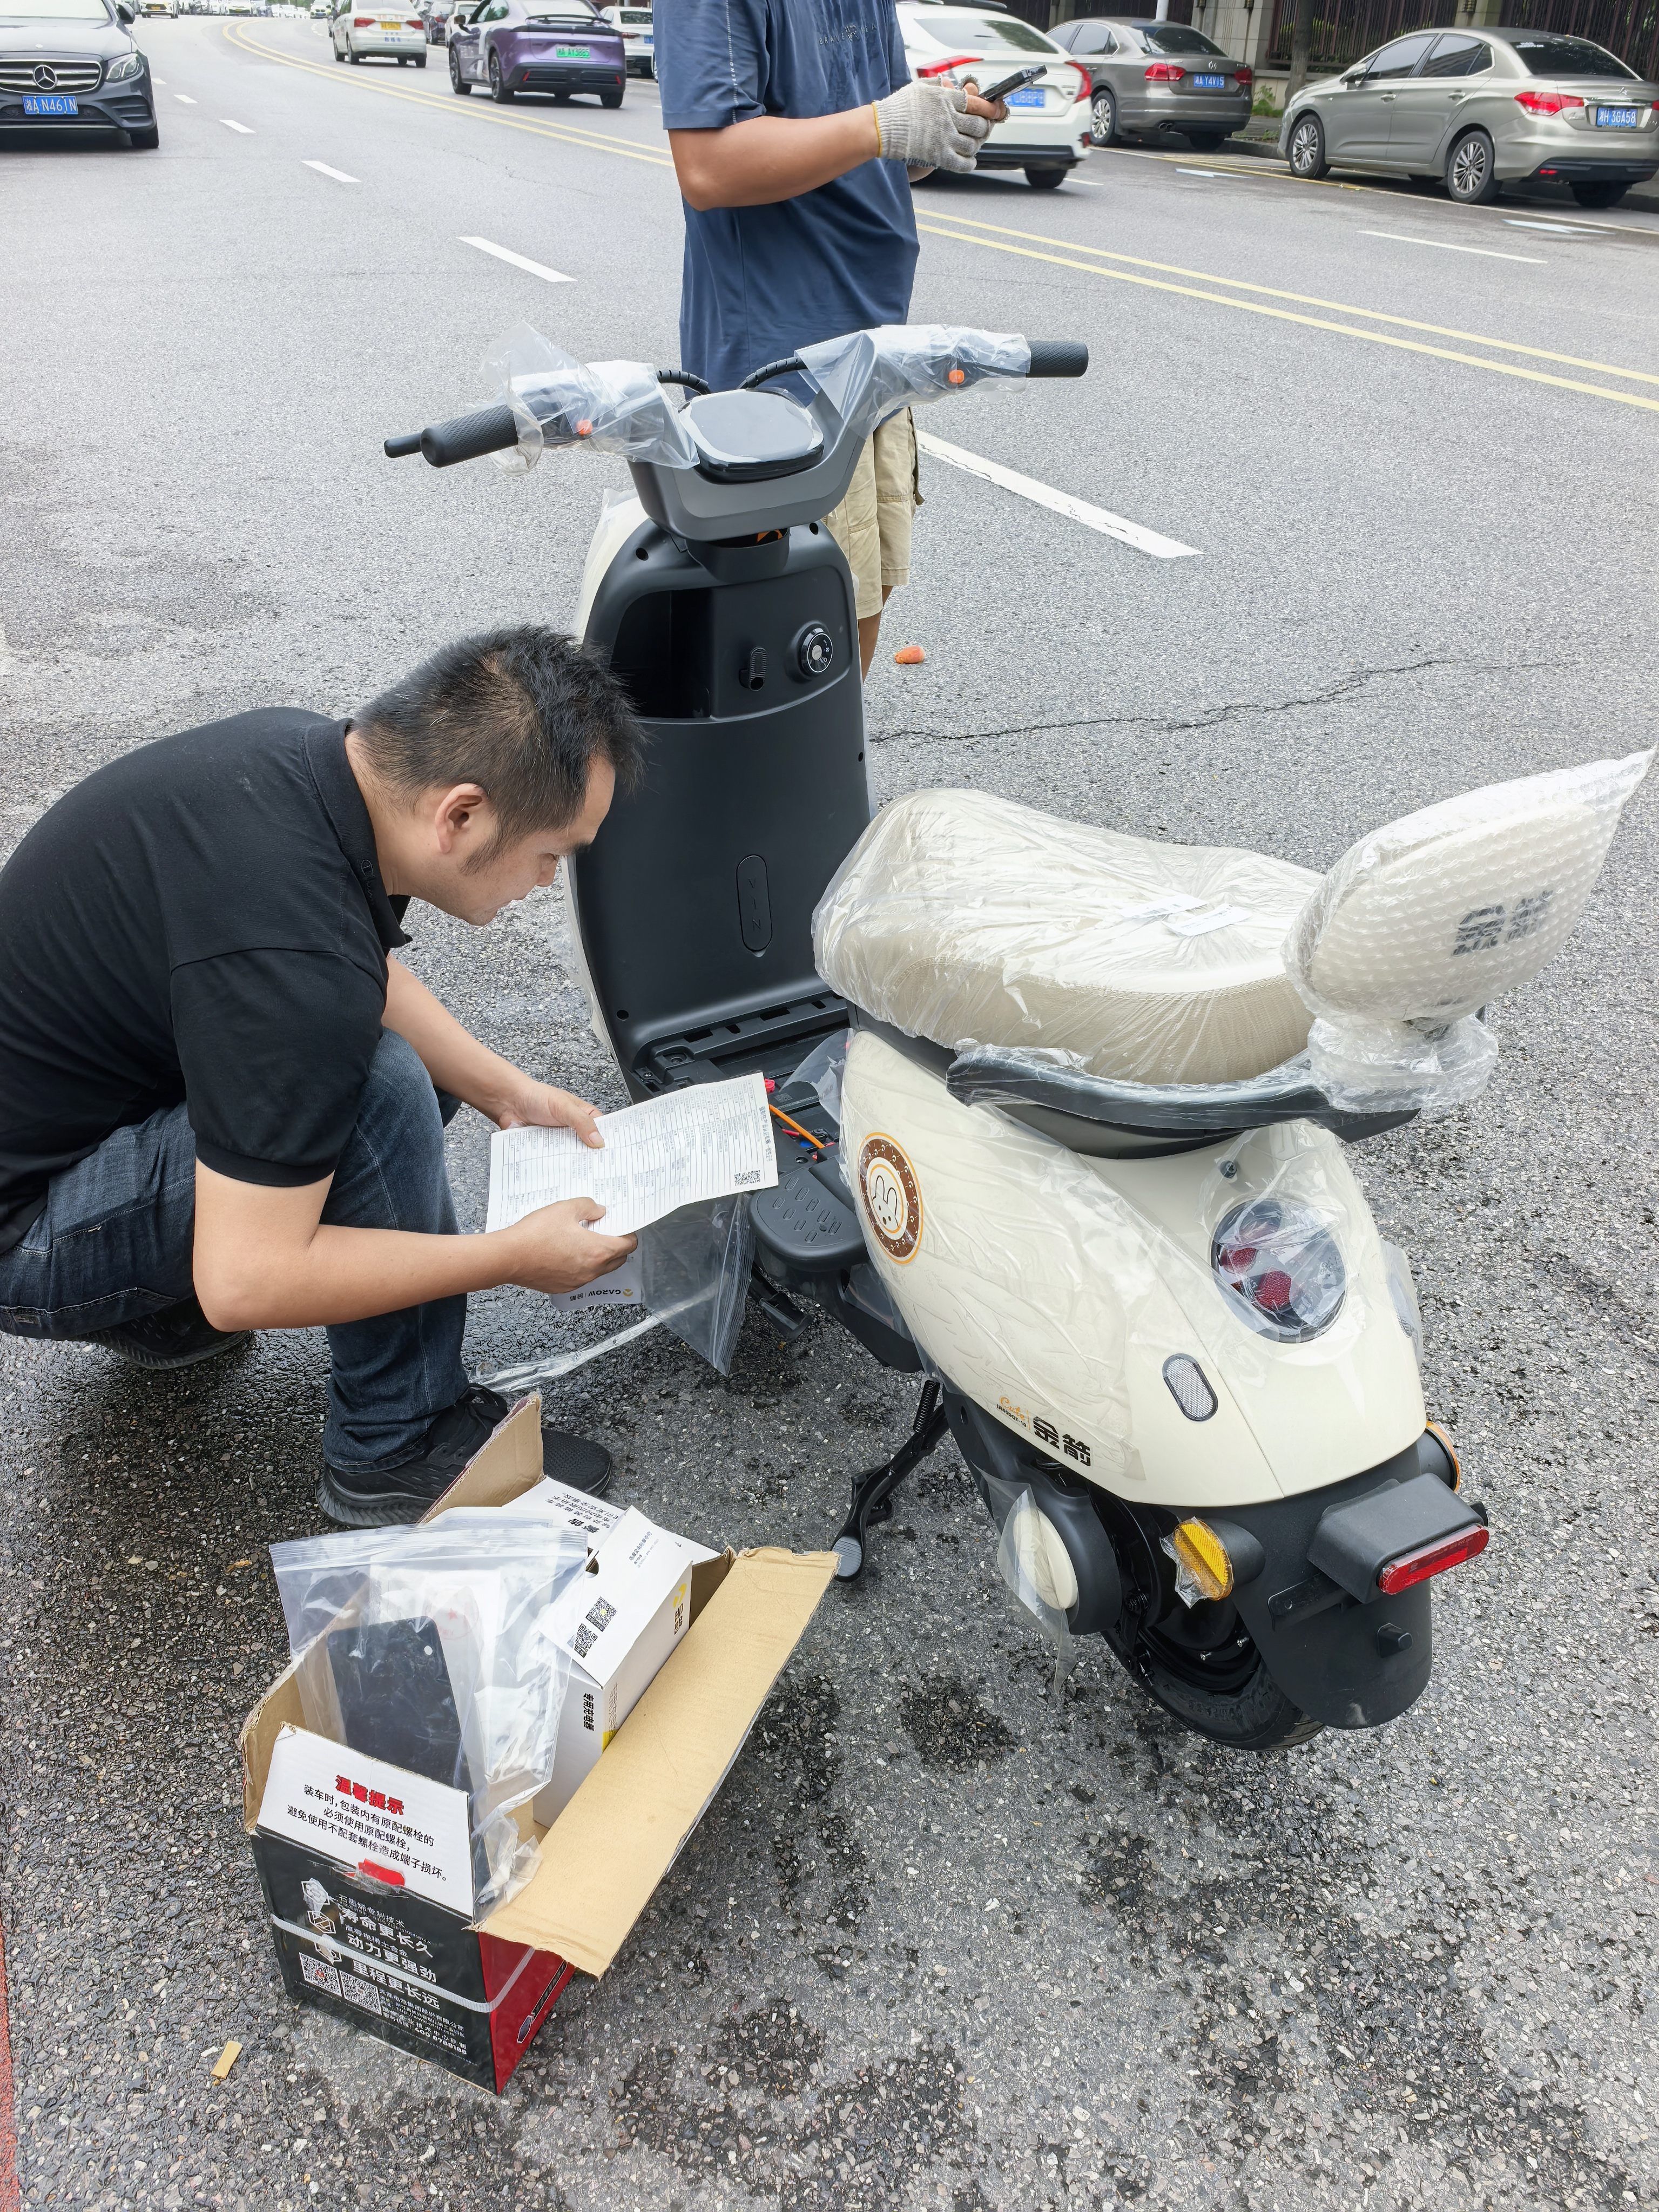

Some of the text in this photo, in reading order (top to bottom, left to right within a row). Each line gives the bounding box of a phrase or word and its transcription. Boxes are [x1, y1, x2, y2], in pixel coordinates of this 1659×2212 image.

[1000, 1397, 1025, 1420] Cute
[1033, 1416, 1091, 1467] 金箭
[583, 1693, 595, 1731] 专用充电器
[335, 1775, 404, 1815] 温馨提示
[343, 1908, 433, 1953] 寿命更长久
[347, 1933, 437, 1983] 动力更强劲
[353, 1959, 440, 2010] 里程更长远
